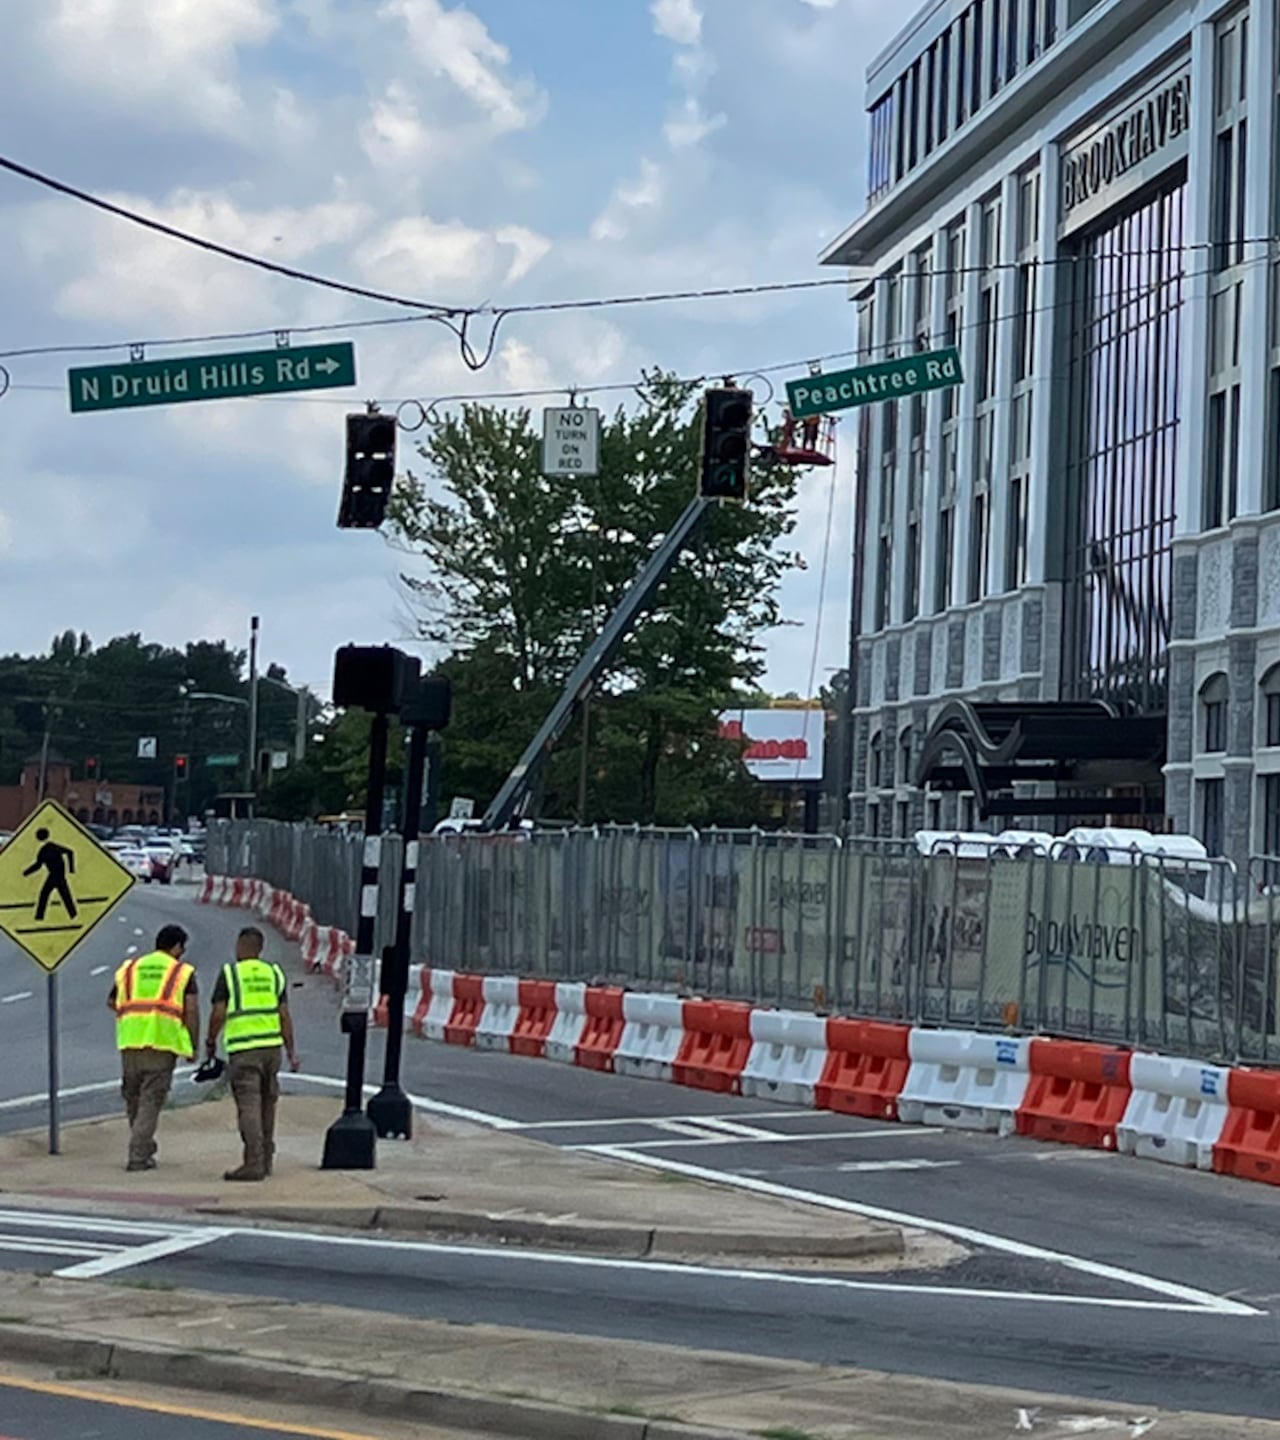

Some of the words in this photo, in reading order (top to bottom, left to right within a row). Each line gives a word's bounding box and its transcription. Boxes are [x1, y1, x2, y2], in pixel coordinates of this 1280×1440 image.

[81, 378, 99, 401] N
[111, 369, 188, 398] Druid
[200, 363, 265, 391] Hills
[276, 358, 310, 382] Rd
[793, 368, 917, 408] Peachtree
[926, 357, 955, 381] Rd
[560, 413, 584, 426] NO
[556, 430, 587, 441] TURN
[562, 443, 579, 455] ON
[558, 457, 582, 469] RED
